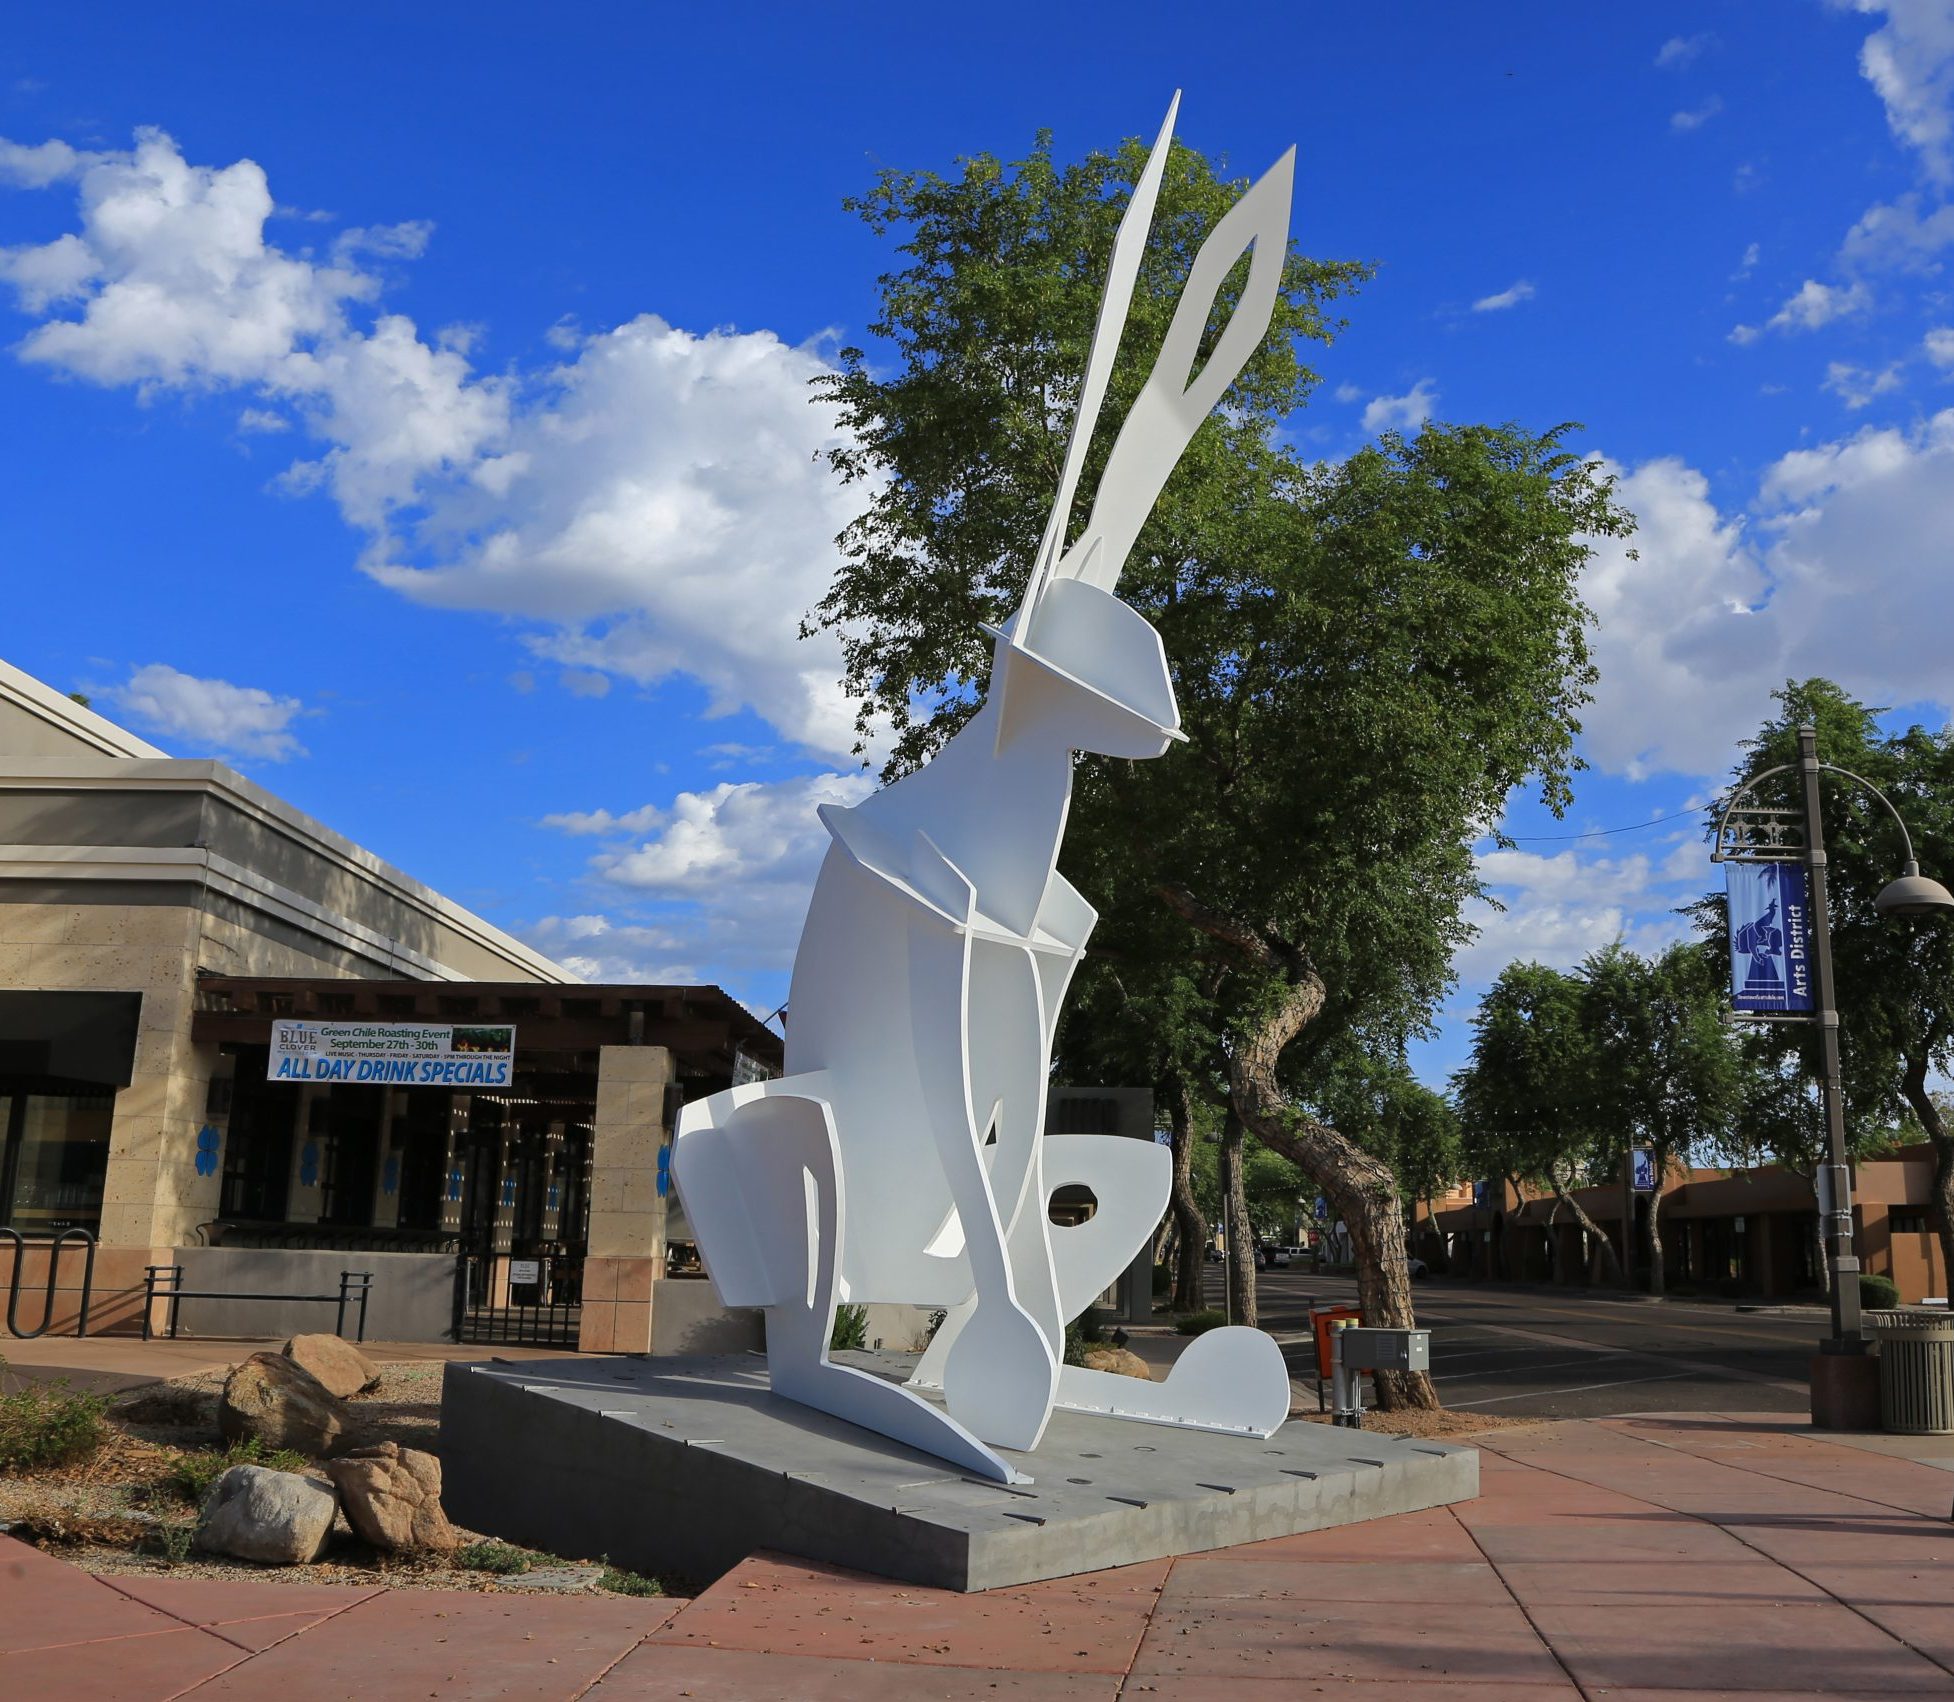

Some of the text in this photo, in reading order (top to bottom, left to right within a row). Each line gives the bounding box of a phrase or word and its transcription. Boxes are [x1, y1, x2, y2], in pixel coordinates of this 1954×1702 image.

[1788, 904, 1807, 997] Arts District
[280, 1030, 317, 1044] BLUE
[321, 1027, 450, 1040] Green Chile Roasting Event
[330, 1039, 386, 1050] September
[386, 1040, 409, 1050] 27th
[415, 1040, 438, 1050] 30th
[276, 1057, 508, 1084] ALL DAY DRINK SPECIALS
